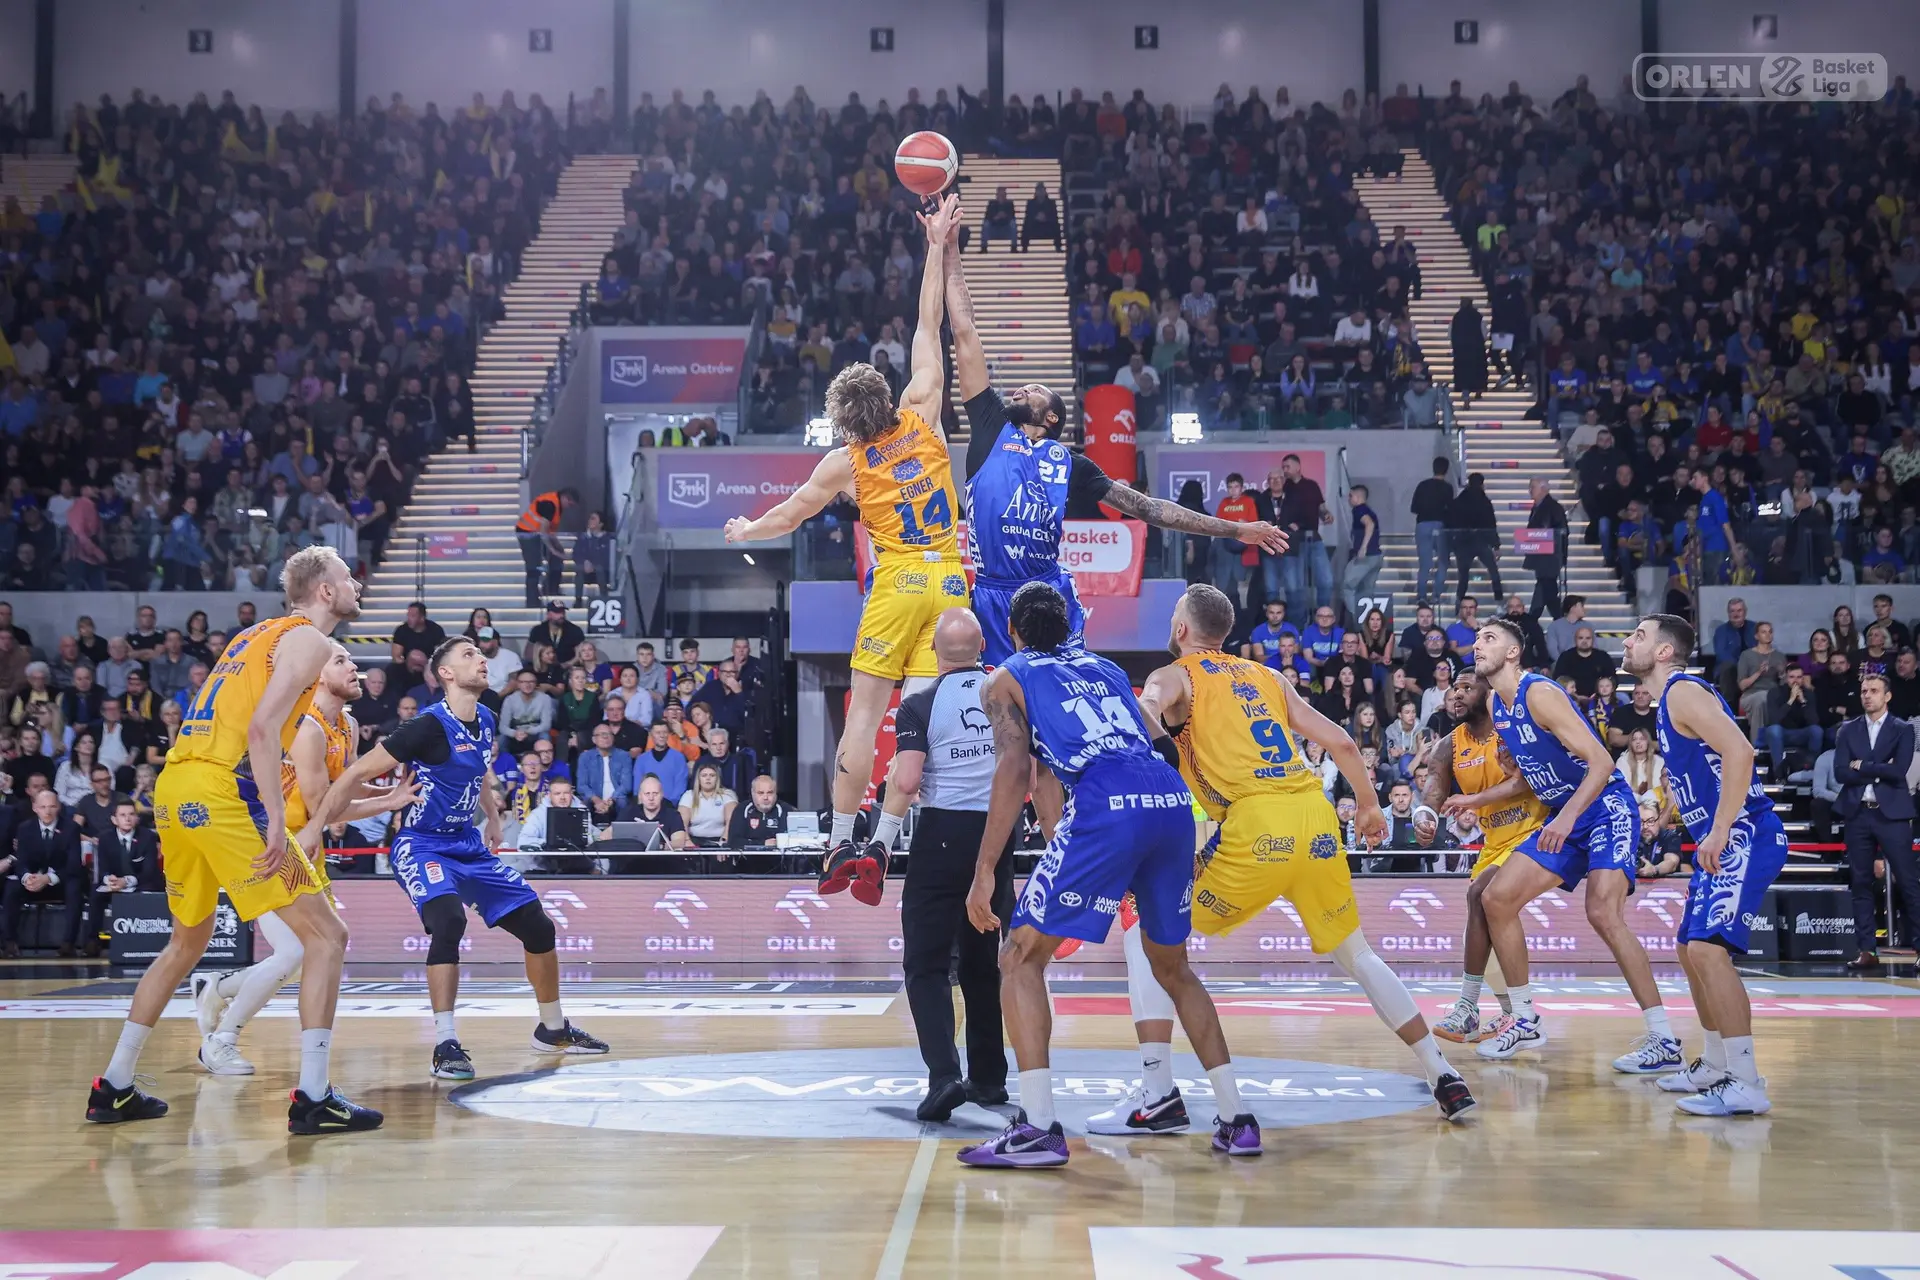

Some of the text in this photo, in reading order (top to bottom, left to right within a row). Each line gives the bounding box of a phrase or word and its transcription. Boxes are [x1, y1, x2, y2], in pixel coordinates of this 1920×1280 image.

[616, 361, 735, 378] 3mk Arena Ostrów
[880, 429, 920, 453] COLOSSEUM
[1038, 460, 1068, 484] 21
[673, 480, 799, 498] 3mk Arena Ostró
[899, 476, 934, 501] EGNER
[1217, 480, 1258, 493] Ana
[893, 487, 952, 539] 14
[1058, 548, 1093, 566] iga
[589, 599, 622, 627] 26
[1357, 597, 1390, 624] 27
[184, 676, 227, 721] 11
[1060, 695, 1142, 743] 14
[1249, 718, 1294, 764] 9
[1515, 723, 1538, 745] 18
[950, 745, 981, 760] Bank
[1524, 762, 1562, 791] nwil
[1489, 806, 1523, 822] OSTRÓW
[1490, 811, 1532, 829] WIELKOPOLSKI
[1251, 833, 1296, 857] Grześ
[1094, 895, 1121, 908] JAWO
[1810, 917, 1855, 926] COLOSSEUM
[208, 938, 238, 948] SIEK
[555, 936, 594, 951] LEN
[644, 936, 715, 951] ORLEN
[766, 936, 836, 951] ORLEN
[1381, 936, 1452, 951] ORLEN
[1524, 936, 1577, 951] RLEN
